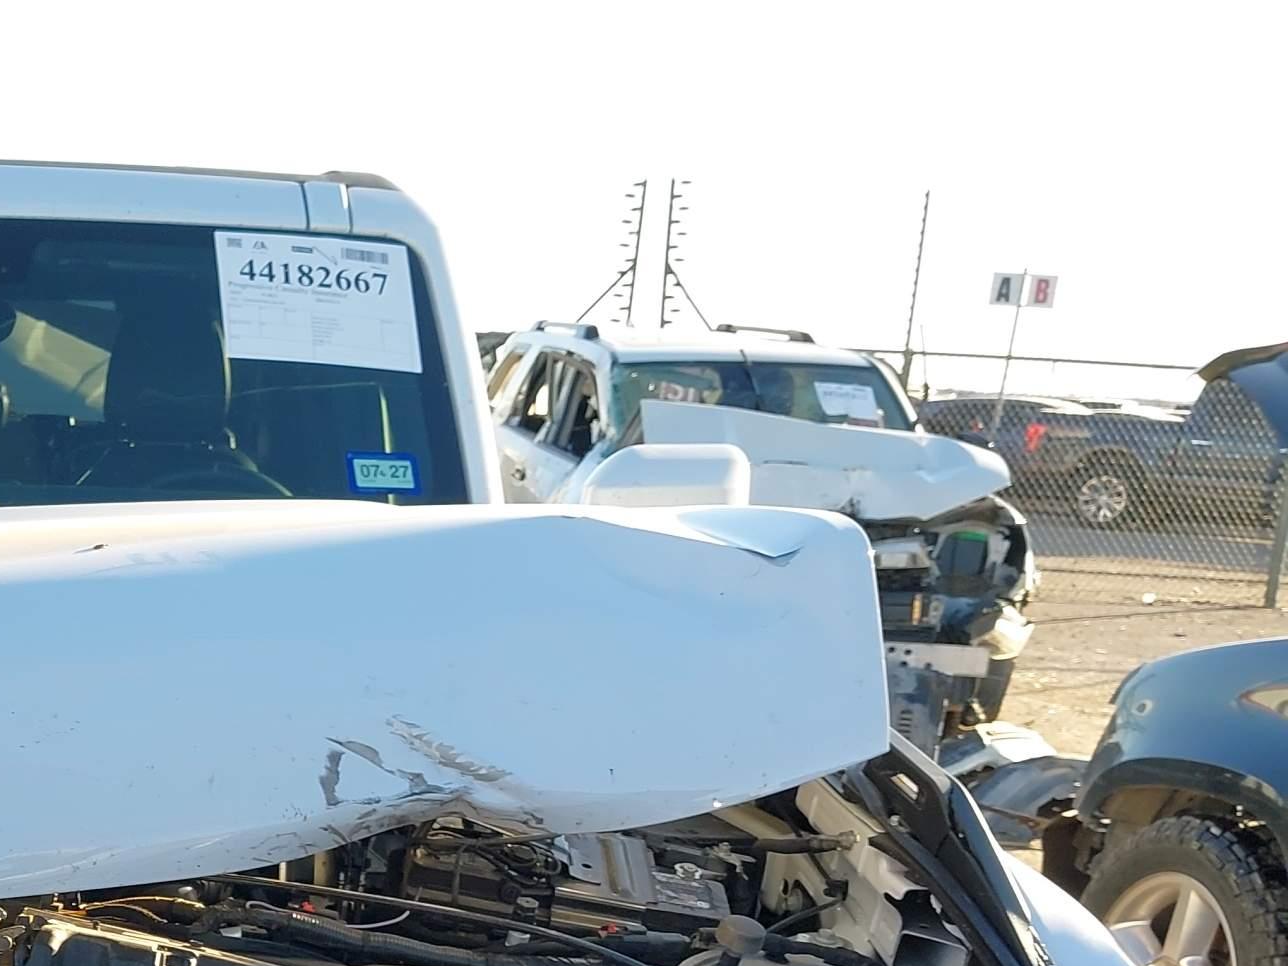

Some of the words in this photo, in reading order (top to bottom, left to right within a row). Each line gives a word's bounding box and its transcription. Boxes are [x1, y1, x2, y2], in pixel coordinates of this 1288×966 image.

[240, 259, 388, 295] 44182667
[996, 277, 1011, 302] A
[1034, 279, 1050, 304] B
